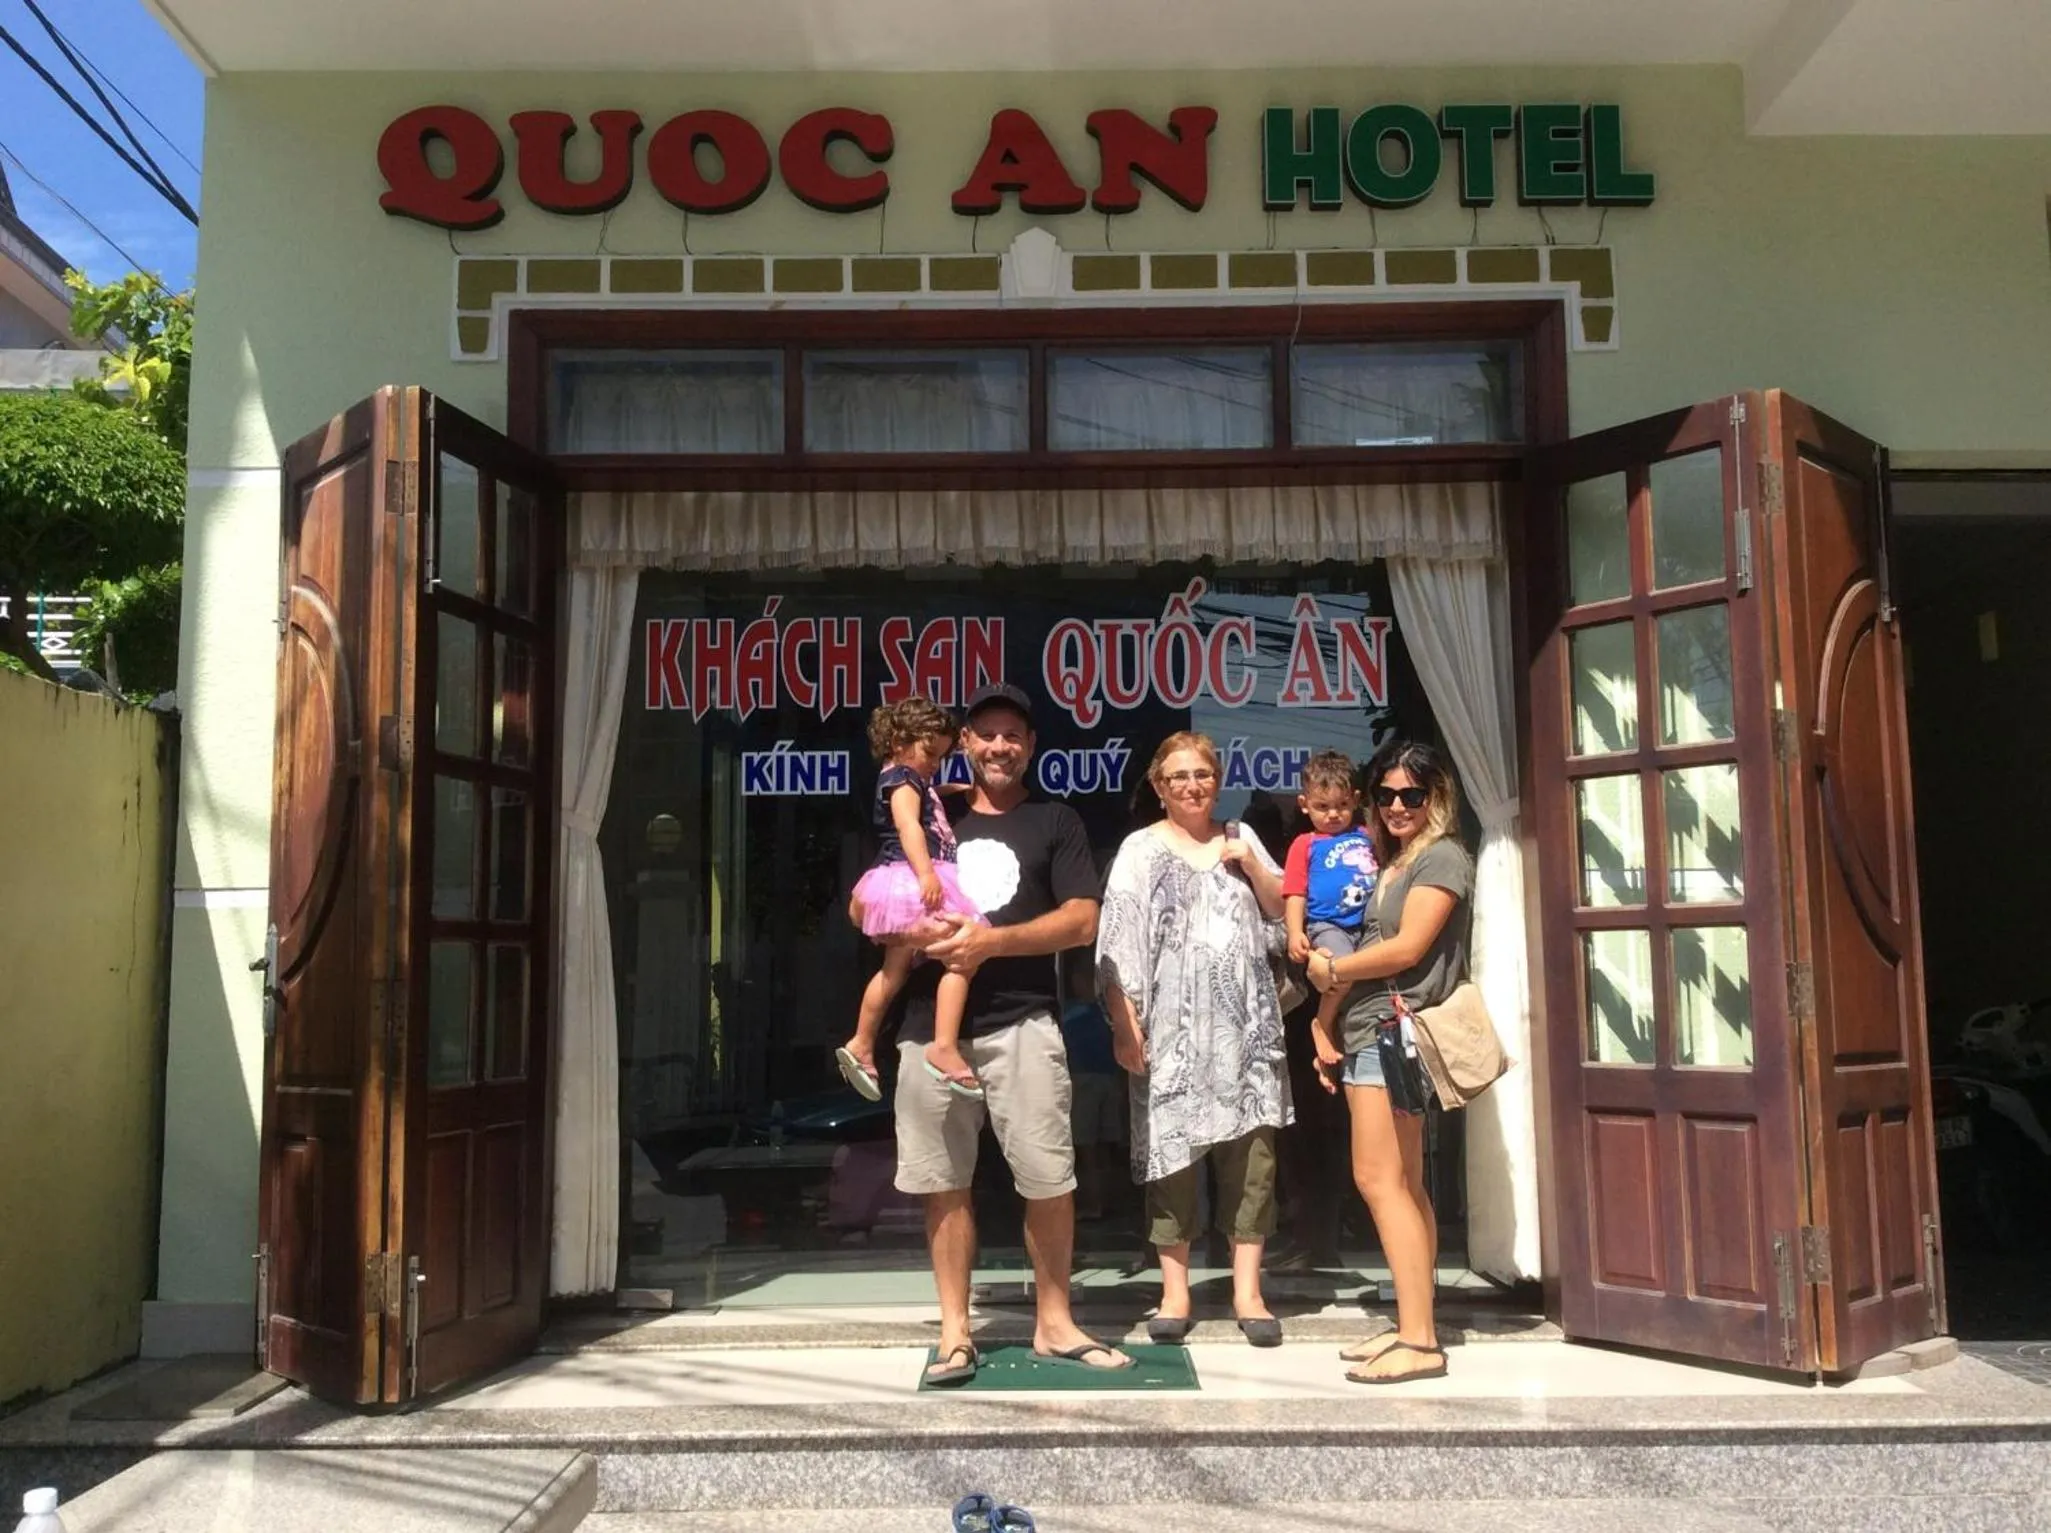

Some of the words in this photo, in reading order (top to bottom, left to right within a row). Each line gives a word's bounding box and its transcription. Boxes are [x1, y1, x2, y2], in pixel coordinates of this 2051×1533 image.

[378, 105, 894, 231] QUOC
[951, 105, 1218, 215] AN
[1262, 103, 1655, 211] HOTEL
[645, 595, 862, 723] KHÁCH
[1043, 576, 1256, 728] QUỐC
[1277, 593, 1393, 707] ÂN
[741, 740, 850, 796] KÍNH
[1039, 737, 1132, 797] QUÝ
[1214, 736, 1312, 791] ÁCH
